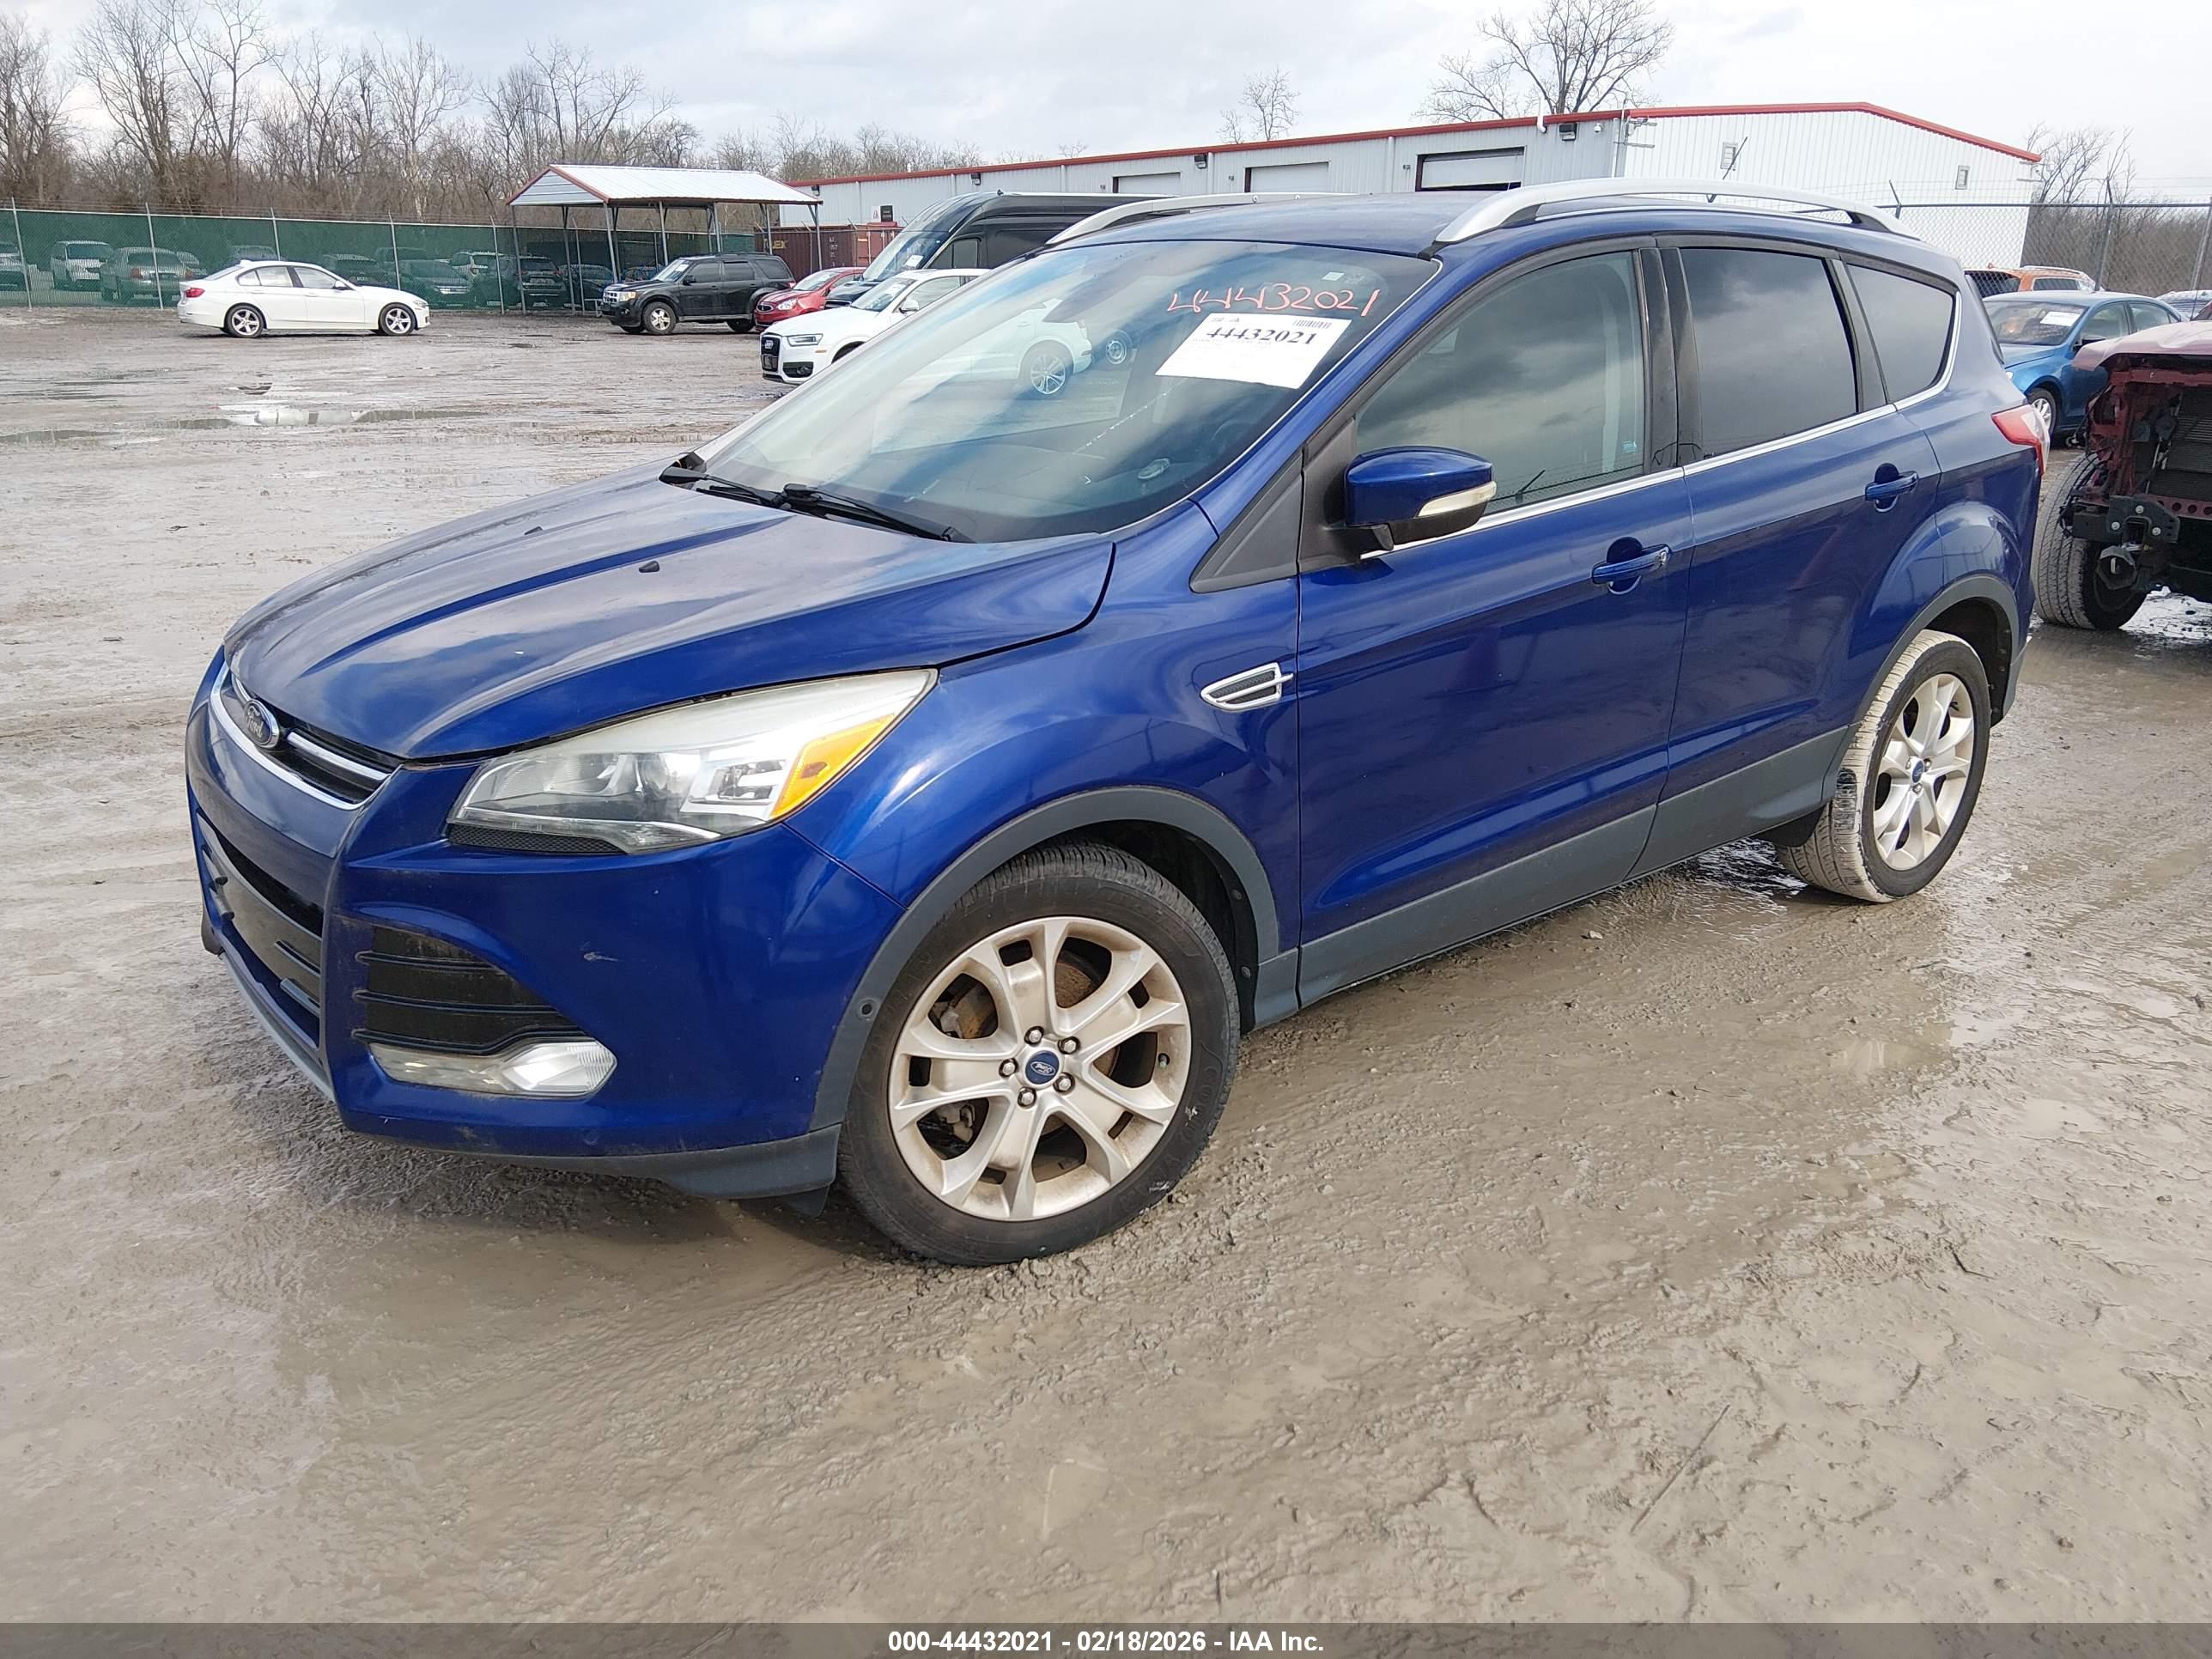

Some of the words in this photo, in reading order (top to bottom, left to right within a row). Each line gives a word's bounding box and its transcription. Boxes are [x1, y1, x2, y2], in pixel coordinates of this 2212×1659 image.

[1167, 283, 1381, 317] 44432021
[1206, 327, 1317, 344] 44432021
[247, 706, 264, 738] Ford
